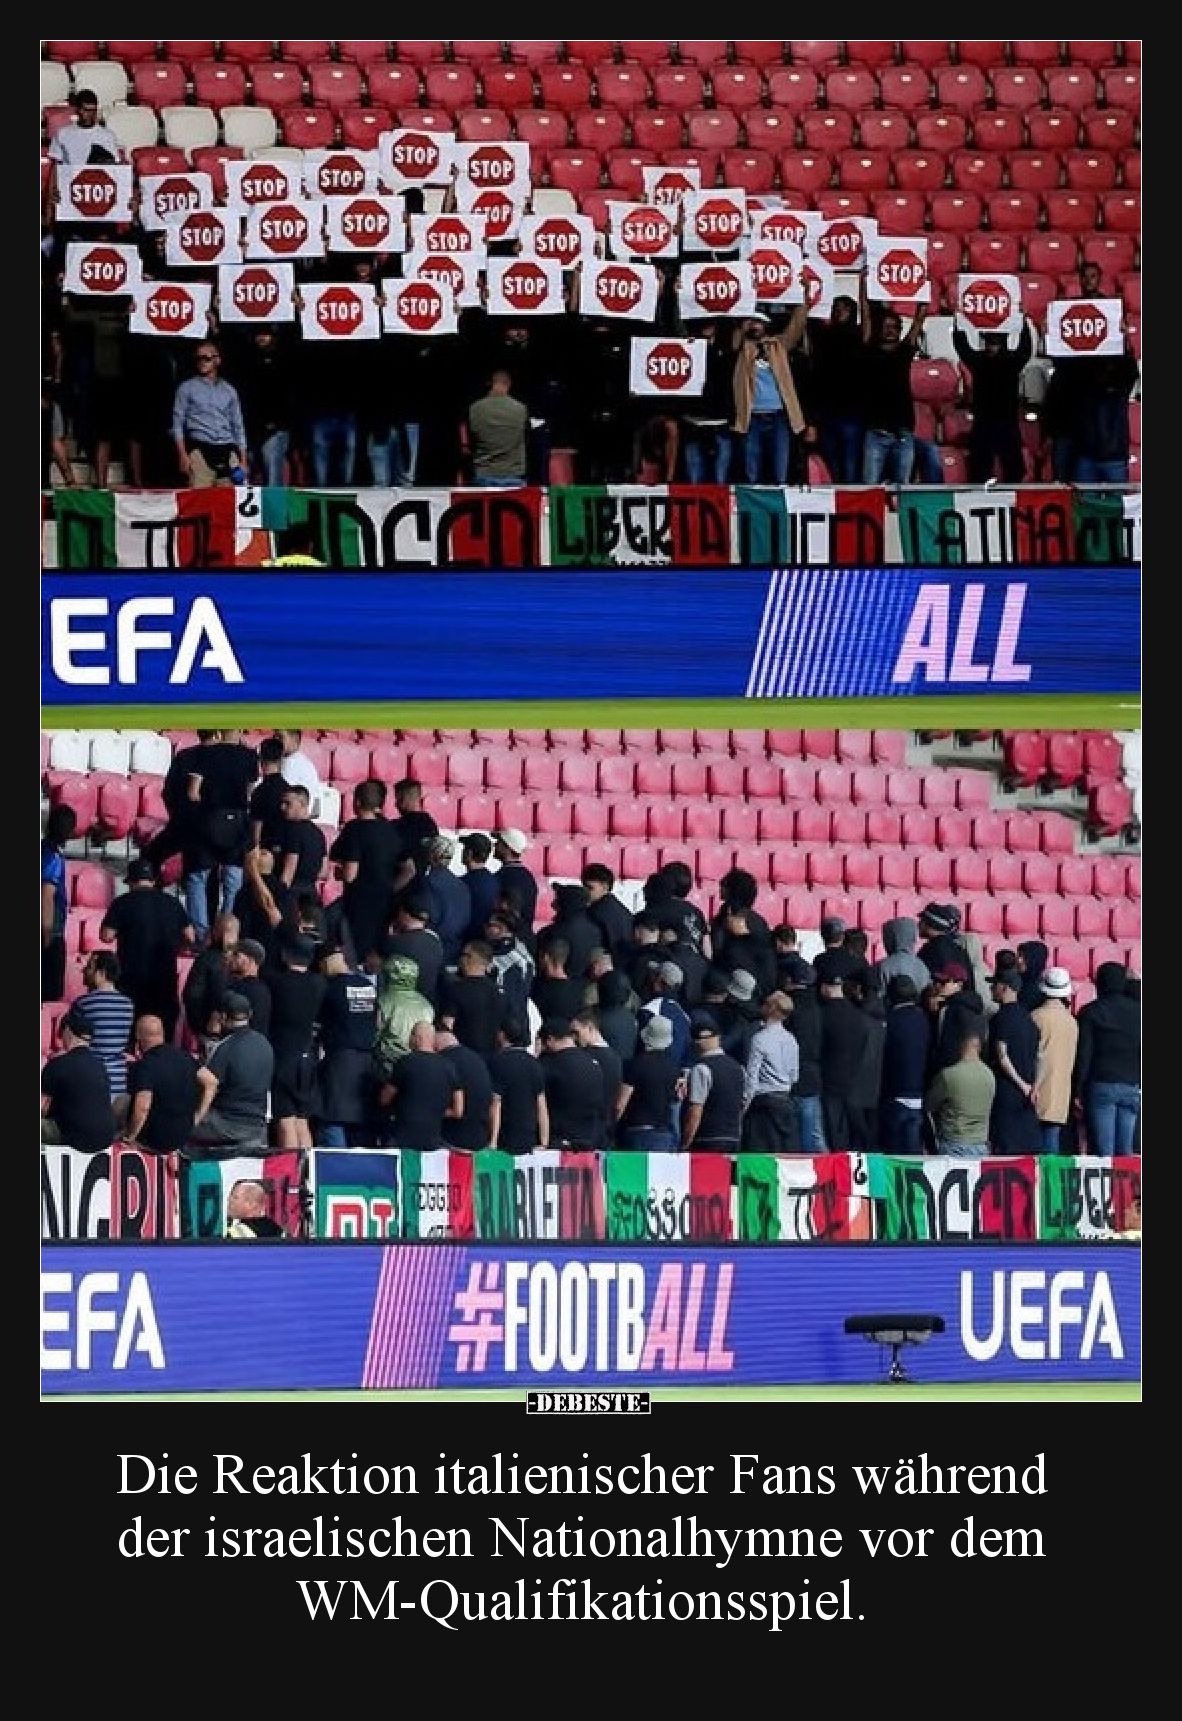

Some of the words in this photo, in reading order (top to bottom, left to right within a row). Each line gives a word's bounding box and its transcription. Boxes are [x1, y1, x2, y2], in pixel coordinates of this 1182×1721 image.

[393, 147, 438, 165] STOP
[320, 169, 364, 188] STOP
[469, 160, 513, 179] STOP
[71, 186, 116, 204] STOP
[243, 179, 287, 198] STOP
[156, 192, 199, 213] STOP
[261, 219, 306, 238] STOP
[344, 214, 388, 232] STOP
[623, 222, 669, 241] STOP
[698, 214, 741, 232] STOP
[181, 228, 225, 246] STOP
[428, 232, 471, 250] STOP
[537, 233, 579, 252] STOP
[763, 226, 806, 244] STOP
[819, 234, 861, 252] STOP
[82, 263, 125, 281] STOP
[752, 264, 791, 283] TOP
[880, 264, 924, 283] STOP
[236, 284, 277, 302] STOP
[504, 277, 547, 296] STOP
[599, 278, 640, 299] STOP
[696, 280, 739, 300] STOP
[149, 300, 193, 320] STOP
[318, 302, 361, 321] STOP
[400, 298, 441, 316] STOP
[963, 293, 1009, 314] STOP
[1062, 318, 1106, 338] STOP
[649, 356, 692, 375] STOP
[50, 596, 246, 685] EFA
[892, 582, 1032, 683] ALL
[41, 1271, 167, 1370] EFA
[449, 1260, 735, 1373] #FOOTBALL
[959, 1270, 1125, 1362] UEFA
